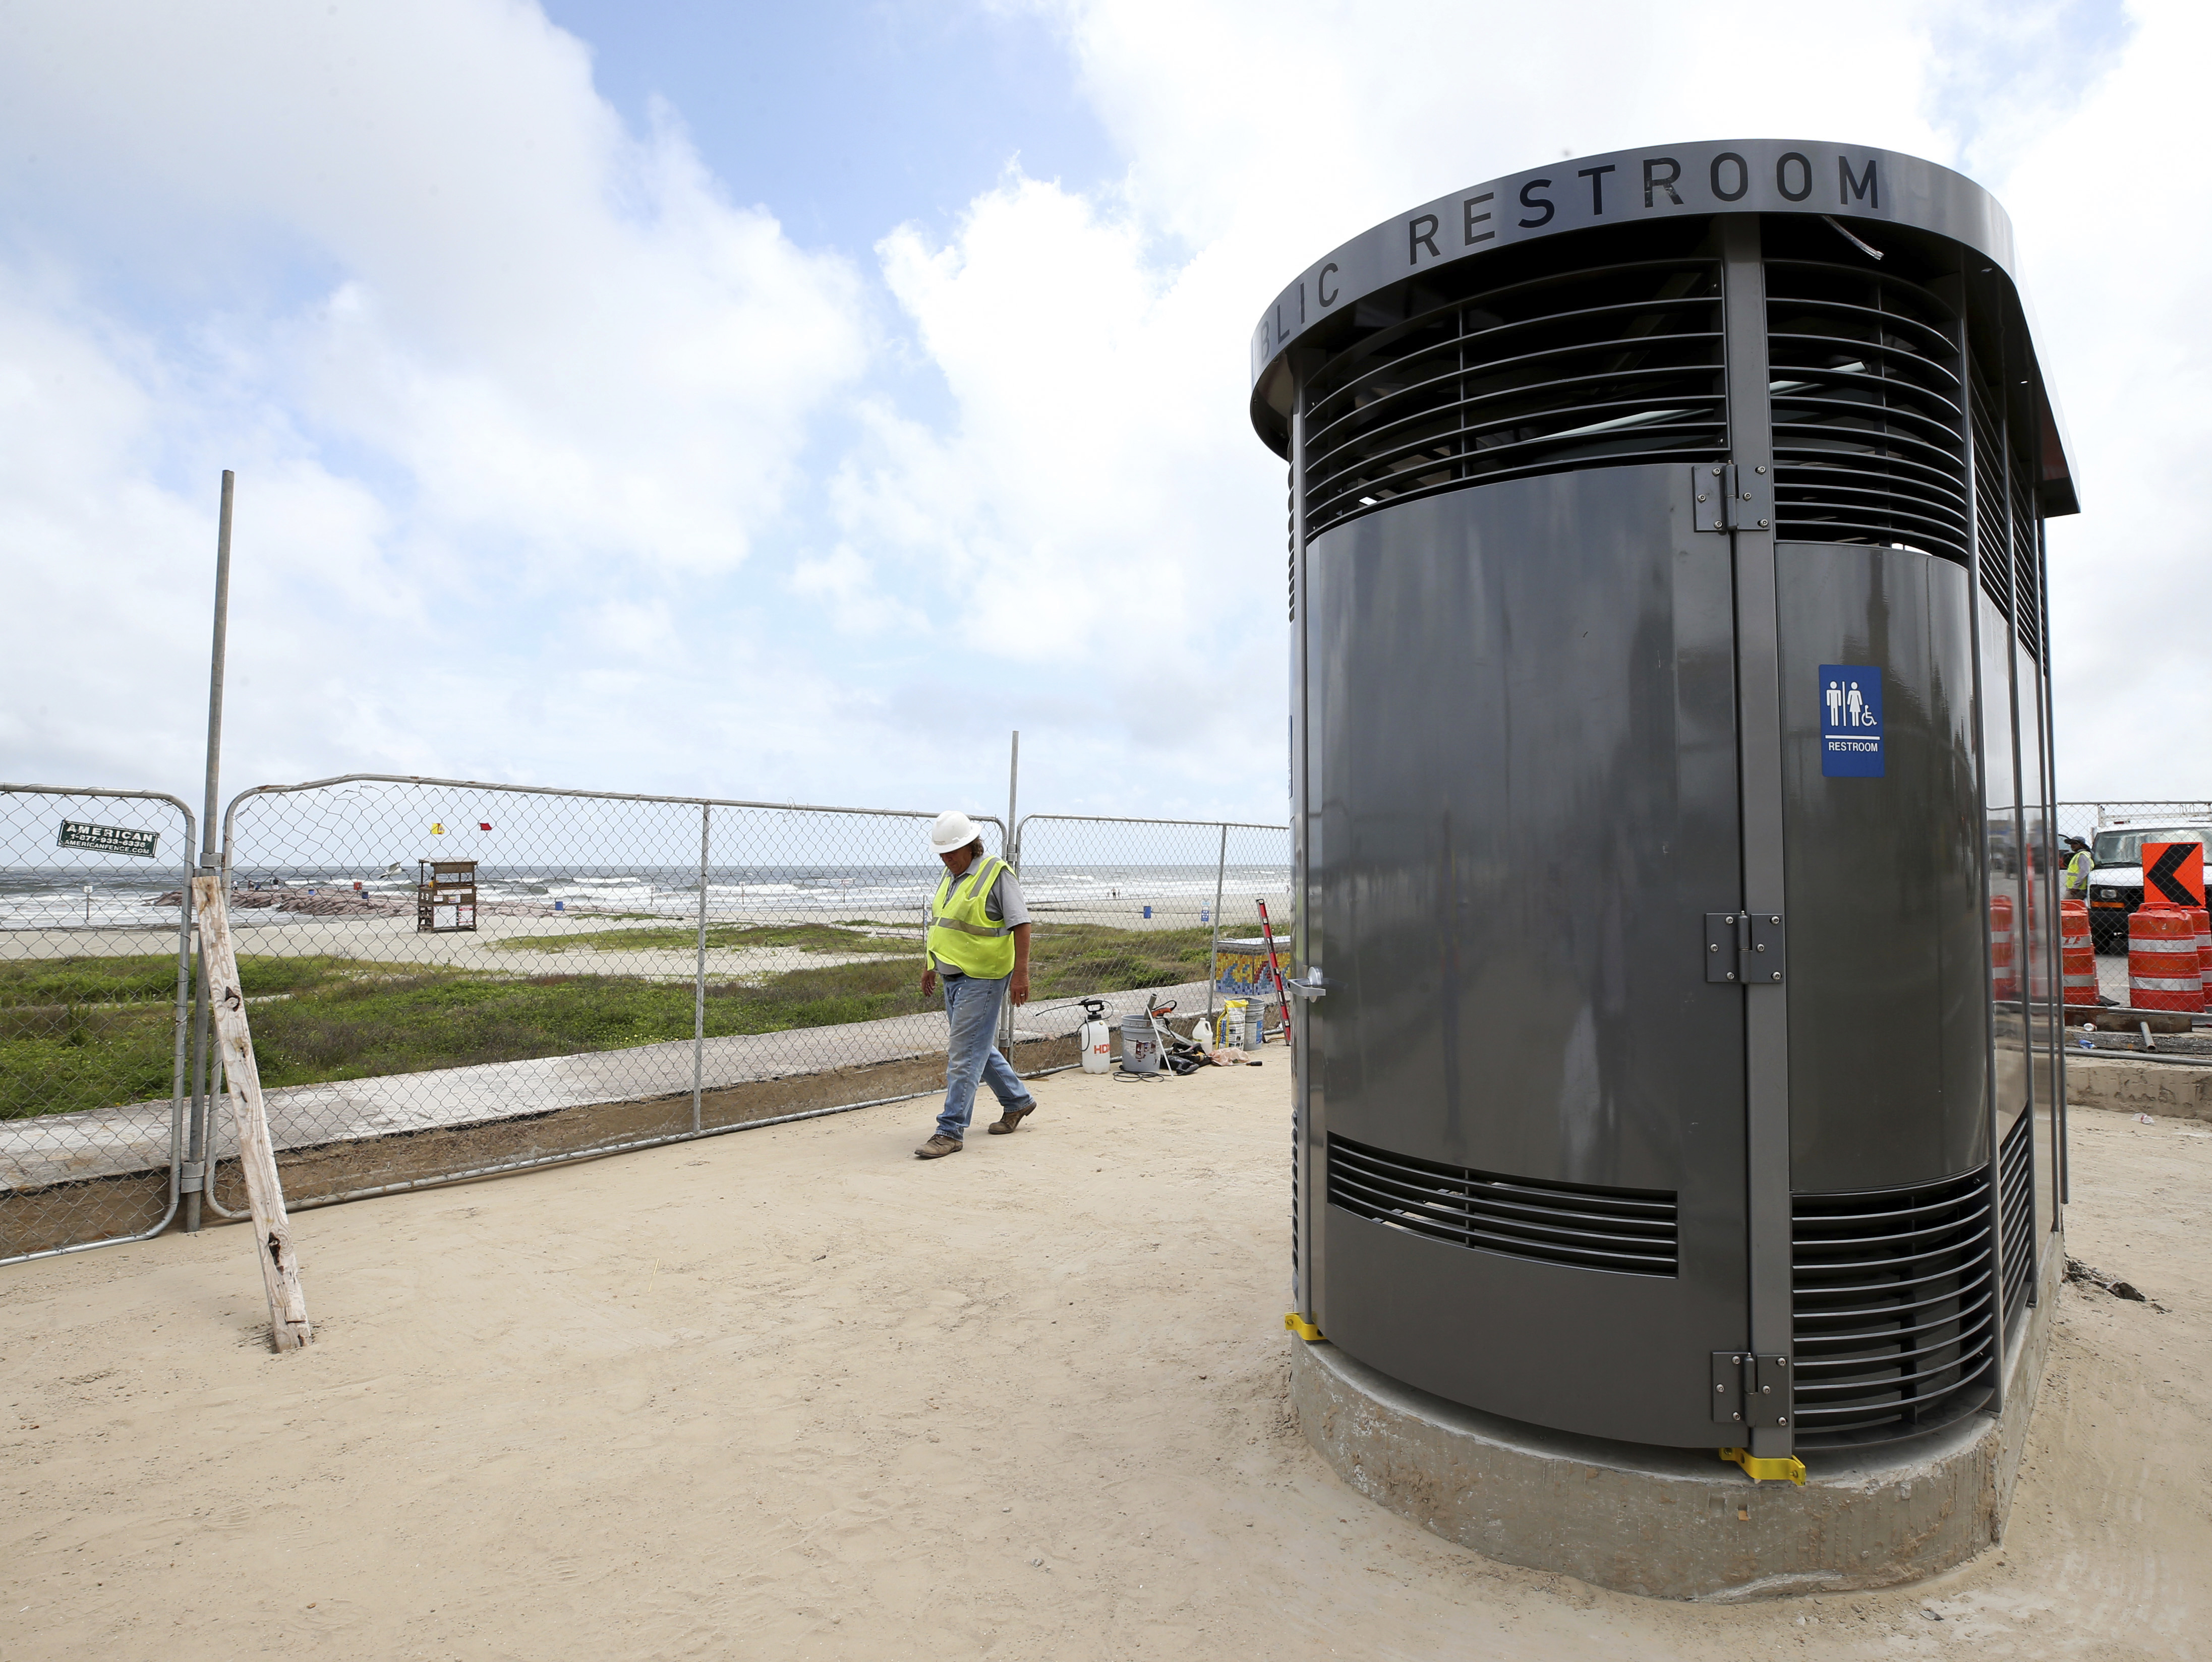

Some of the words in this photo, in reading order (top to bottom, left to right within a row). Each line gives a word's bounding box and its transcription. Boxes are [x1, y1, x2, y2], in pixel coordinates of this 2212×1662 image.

[1255, 262, 1340, 368] BLIC
[1409, 151, 1879, 265] RESTROOM
[1828, 741, 1878, 752] RESTROOM
[66, 824, 153, 842] AMERICAN
[65, 839, 150, 854] AMERICANFENCE.COM
